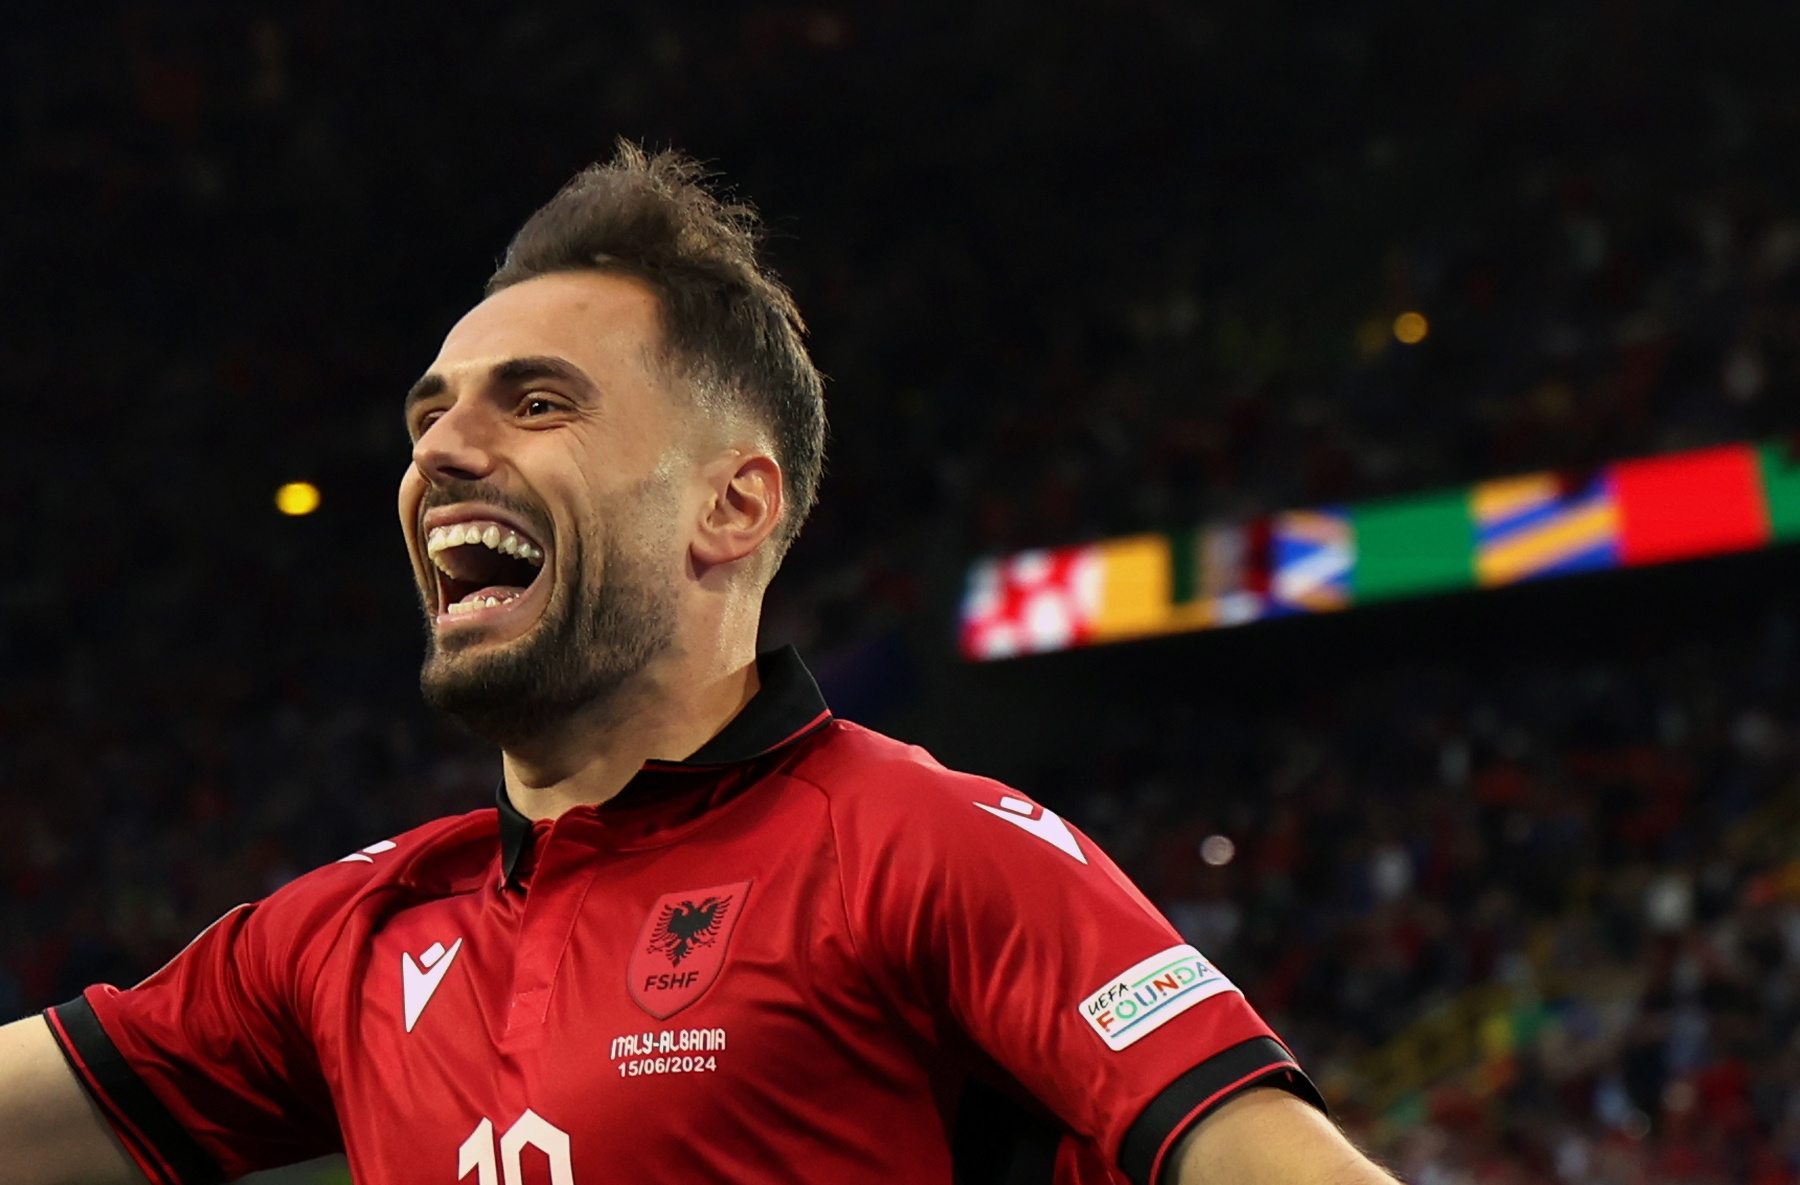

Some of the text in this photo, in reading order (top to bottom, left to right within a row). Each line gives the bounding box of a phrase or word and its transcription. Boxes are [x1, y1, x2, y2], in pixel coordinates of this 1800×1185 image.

[644, 971, 699, 992] FSHF
[1096, 961, 1215, 1032] FOUNDA
[1088, 982, 1129, 1015] UEFA
[610, 1028, 726, 1060] ITALY-ALBANIA
[618, 1056, 717, 1077] 15/06/2024
